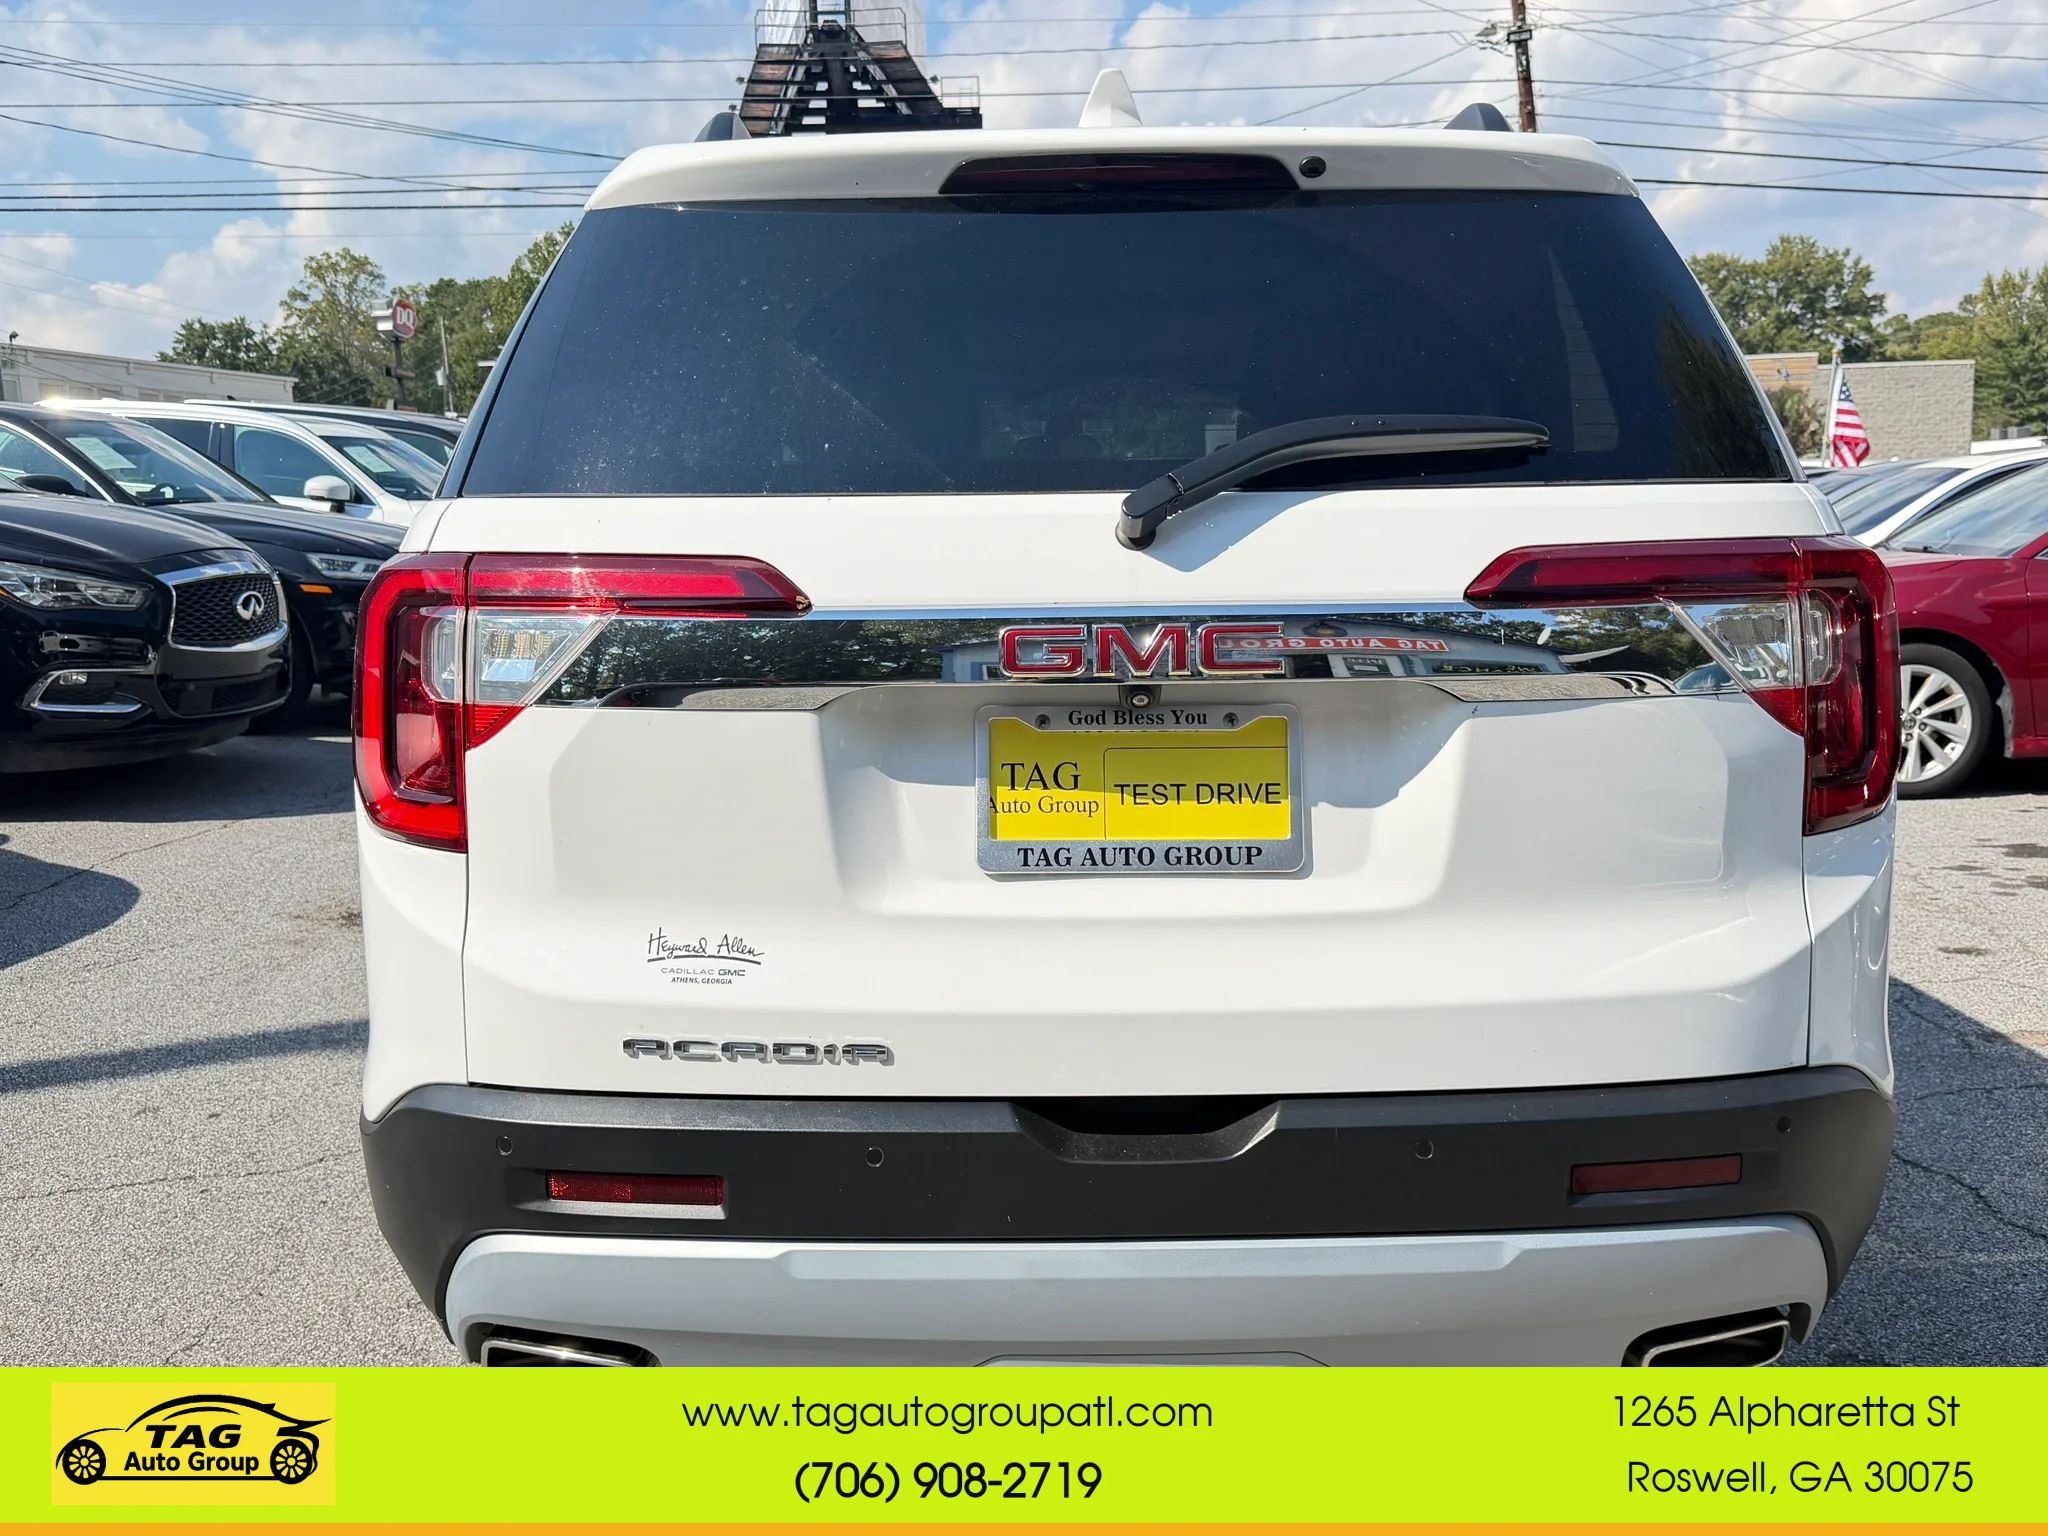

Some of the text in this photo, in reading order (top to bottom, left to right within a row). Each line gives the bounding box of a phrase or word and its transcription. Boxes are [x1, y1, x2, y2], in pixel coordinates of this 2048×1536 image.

[396, 306, 414, 329] DQ
[999, 622, 1285, 677] GMC
[1067, 710, 1208, 726] God Bless You
[1001, 761, 1081, 791] TAG
[1113, 783, 1282, 805] TEST DRIVE
[989, 795, 1099, 818] Auto Group
[1017, 846, 1263, 867] TAG AUTO GROUP
[648, 927, 766, 959] Heyward Allen
[661, 967, 746, 977] CADILLAC GMC
[671, 976, 732, 985] ATHENS, GEORGIA
[622, 1038, 894, 1066] ACADIA
